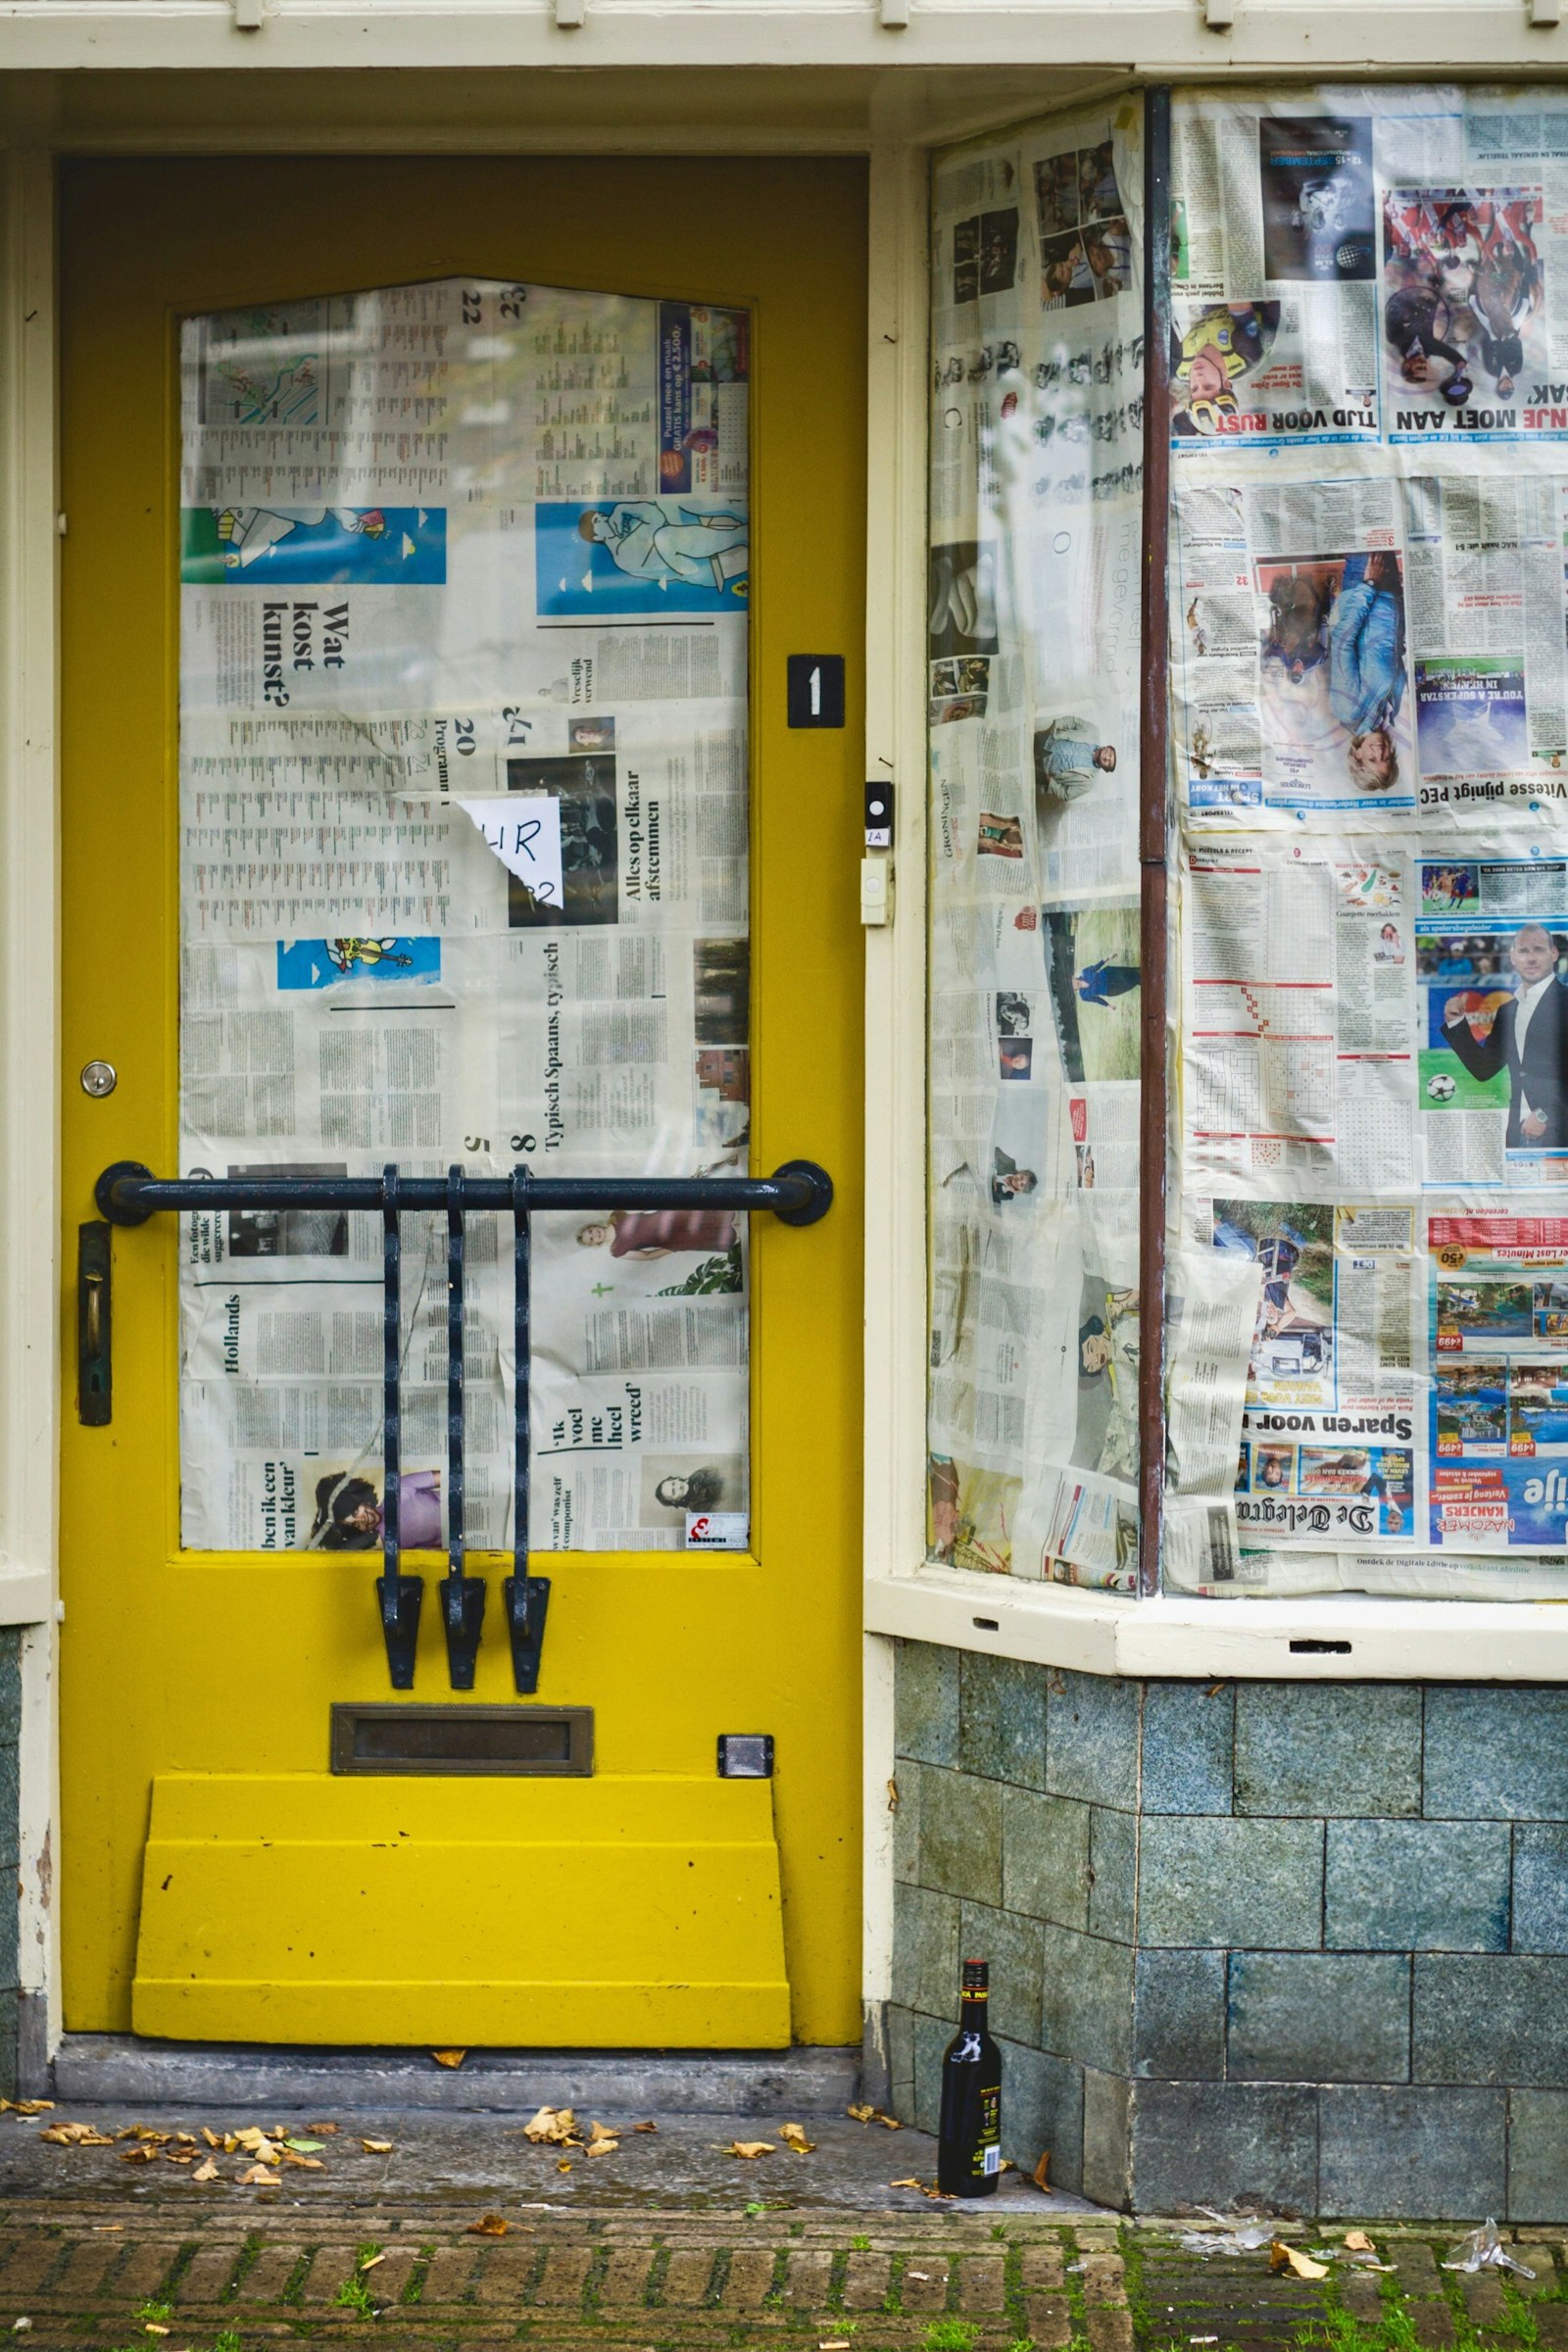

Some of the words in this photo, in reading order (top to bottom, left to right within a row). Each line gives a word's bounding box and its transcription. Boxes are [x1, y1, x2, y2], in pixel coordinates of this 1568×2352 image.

[1270, 157, 1335, 166] SEPTEMBER
[463, 290, 481, 324] 22
[674, 374, 683, 387] op
[673, 390, 682, 413] kans
[663, 407, 672, 437] Puzzel
[1215, 414, 1268, 433] RUST
[1272, 411, 1328, 431] VOOR
[1332, 409, 1377, 429] TIJD
[1396, 412, 1446, 429] AAN
[1452, 410, 1516, 429] MOET
[673, 416, 682, 451] GRATIS
[1388, 536, 1396, 547] 3
[1237, 576, 1250, 586] 32
[1105, 568, 1129, 674] gevormd
[294, 602, 319, 671] kost
[323, 602, 349, 669] Wat
[263, 602, 290, 708] kunst?
[571, 658, 583, 704] Vreselijk
[582, 659, 593, 704] verwend
[808, 666, 821, 715] 1
[1486, 680, 1498, 690] IN
[1420, 692, 1476, 702] SUPERSTAR
[1487, 691, 1524, 701] YOU'RE
[455, 717, 476, 756] 20
[434, 719, 451, 807] Programm
[624, 770, 639, 828] elkaar
[1420, 787, 1449, 805] PEC
[1452, 781, 1504, 802] pijnigt
[1509, 783, 1568, 799] Vitesse
[940, 779, 954, 858] GRONINGEN
[628, 830, 644, 854] op
[645, 801, 661, 902] afstemmen
[625, 857, 640, 902] Alles
[543, 942, 564, 1007] typisch
[544, 1010, 563, 1079] Spaans,
[543, 1082, 564, 1152] Typisch
[465, 1135, 490, 1152] 5
[511, 1134, 536, 1152] 8
[189, 1210, 202, 1243] fotogr
[200, 1218, 210, 1246] wilde
[189, 1243, 200, 1264] Een
[200, 1248, 210, 1264] die
[1441, 1252, 1464, 1263] €50
[1496, 1250, 1535, 1259] Minutes
[1538, 1250, 1557, 1258] Last
[223, 1294, 240, 1374] Hollands
[1438, 1338, 1461, 1347] €499
[566, 1408, 583, 1446] voel
[591, 1416, 603, 1444] me
[606, 1406, 622, 1444] heel
[1256, 1414, 1315, 1433] voor
[1322, 1413, 1412, 1441] Sparen
[1438, 1443, 1462, 1452] €499
[1510, 1443, 1535, 1452] €499
[264, 1462, 275, 1493] een
[553, 1476, 563, 1496] zelf
[1474, 1490, 1506, 1499] Verleng
[1524, 1469, 1568, 1512] ije
[261, 1495, 275, 1513] ik
[1236, 1496, 1331, 1534] Telegra
[1446, 1506, 1504, 1517] KANJERS
[563, 1490, 573, 1544] componist
[1336, 1505, 1375, 1535] De
[1435, 1518, 1516, 1533] NAZOMER
[261, 1517, 275, 1548] ben
[284, 1517, 296, 1548] van
[1396, 1559, 1425, 1568] Digitale
[1449, 1562, 1459, 1571] op
